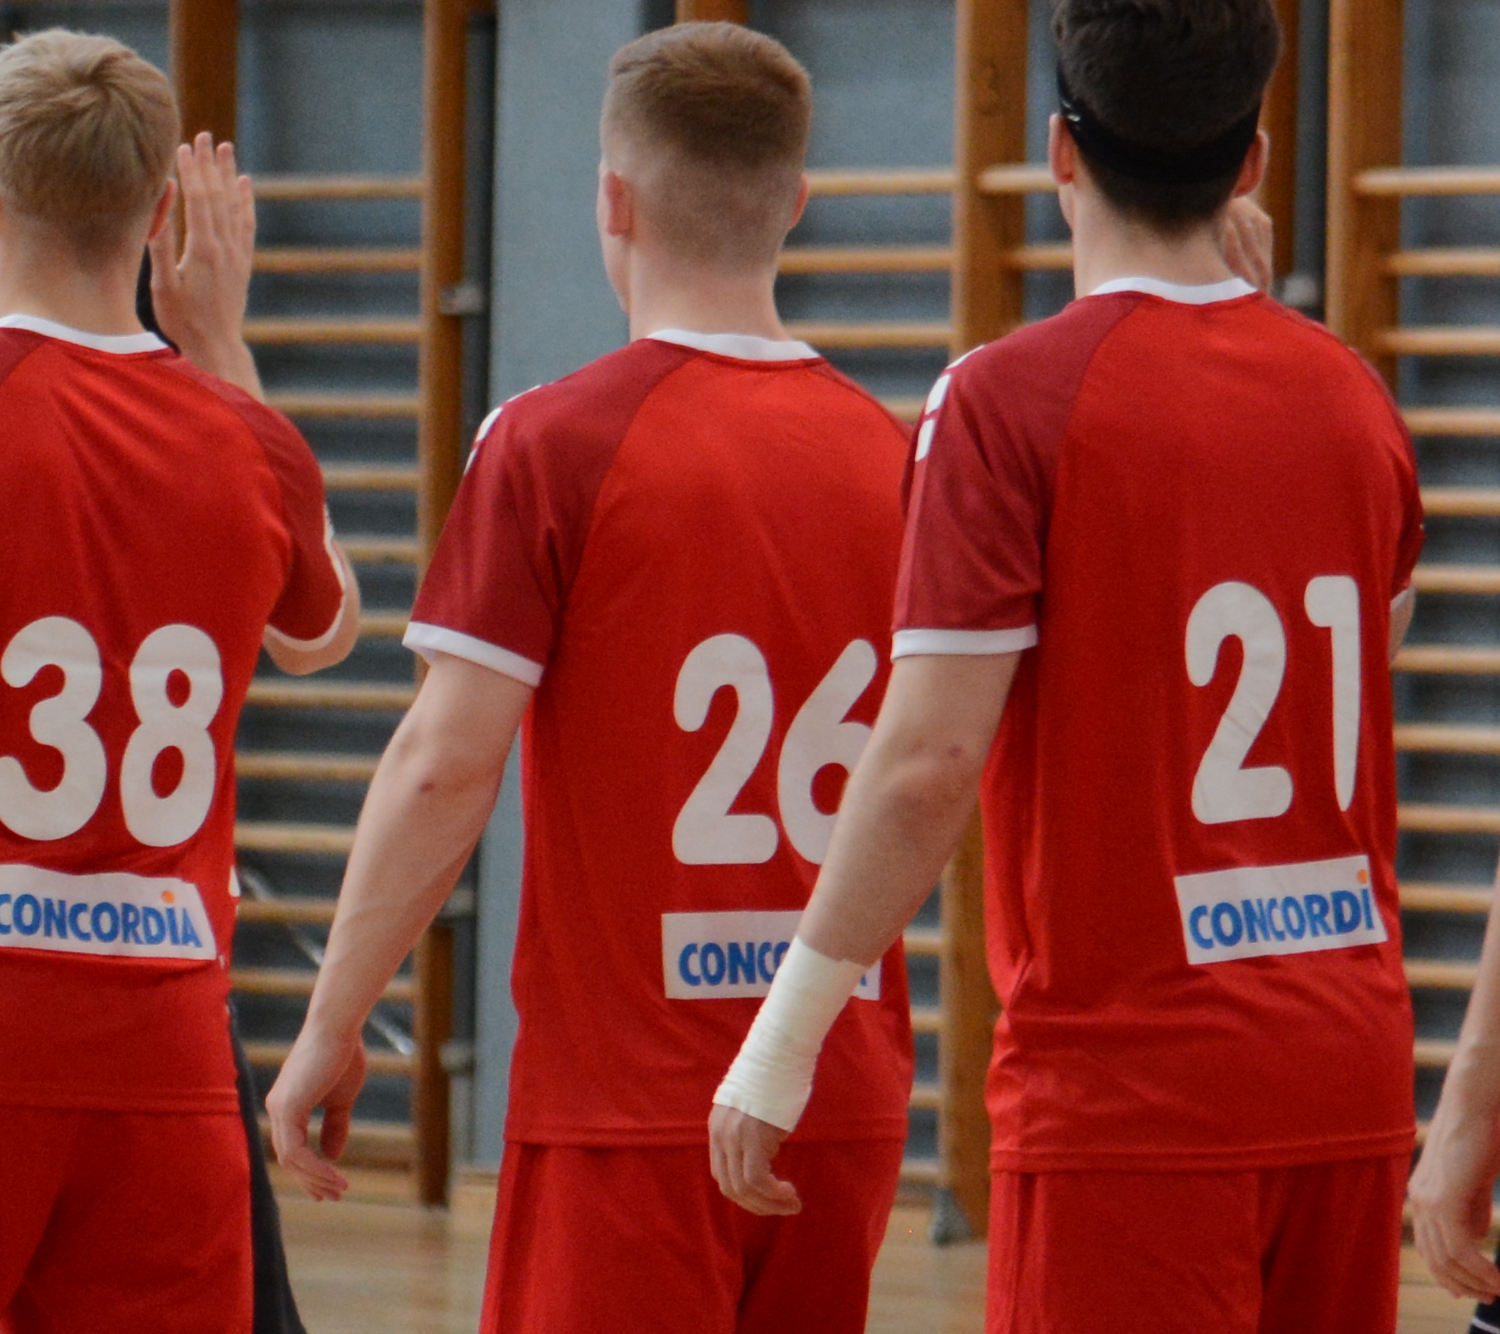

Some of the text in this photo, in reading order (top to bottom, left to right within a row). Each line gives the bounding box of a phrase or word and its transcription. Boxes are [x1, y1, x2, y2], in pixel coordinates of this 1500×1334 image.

[672, 633, 879, 865] 26
[1185, 575, 1362, 825] 21
[1189, 869, 1374, 950] CONCORDI
